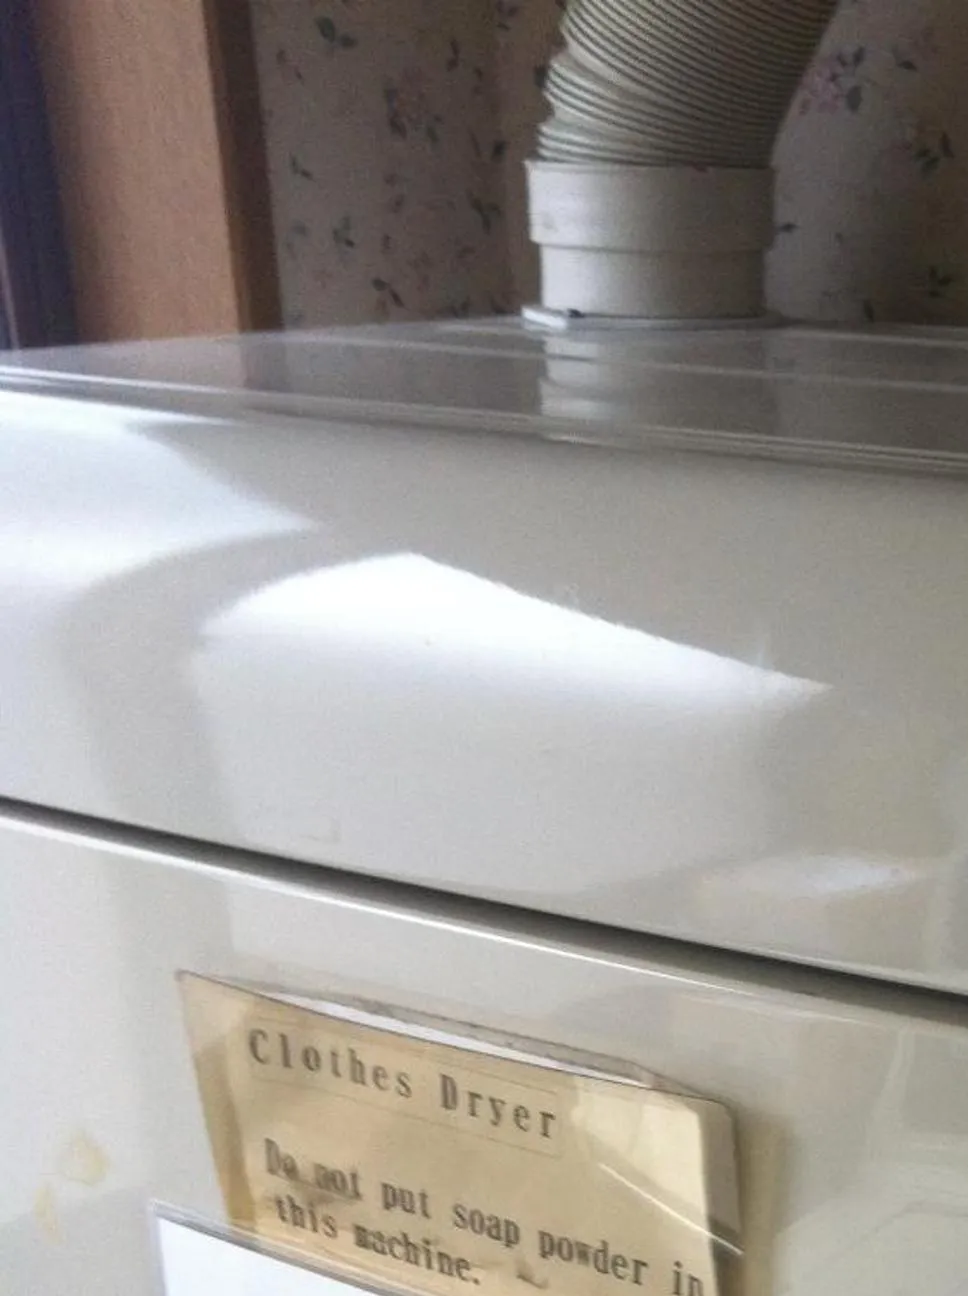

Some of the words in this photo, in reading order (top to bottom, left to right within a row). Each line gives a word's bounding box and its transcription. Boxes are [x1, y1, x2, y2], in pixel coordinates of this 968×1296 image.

[248, 1027, 413, 1099] Clothes
[438, 1072, 558, 1139] Dryer
[273, 1194, 339, 1239] this
[353, 1222, 482, 1286] machine.
[313, 1162, 363, 1200] not
[381, 1181, 432, 1220] put
[452, 1201, 521, 1248] soap
[537, 1229, 648, 1287] powder
